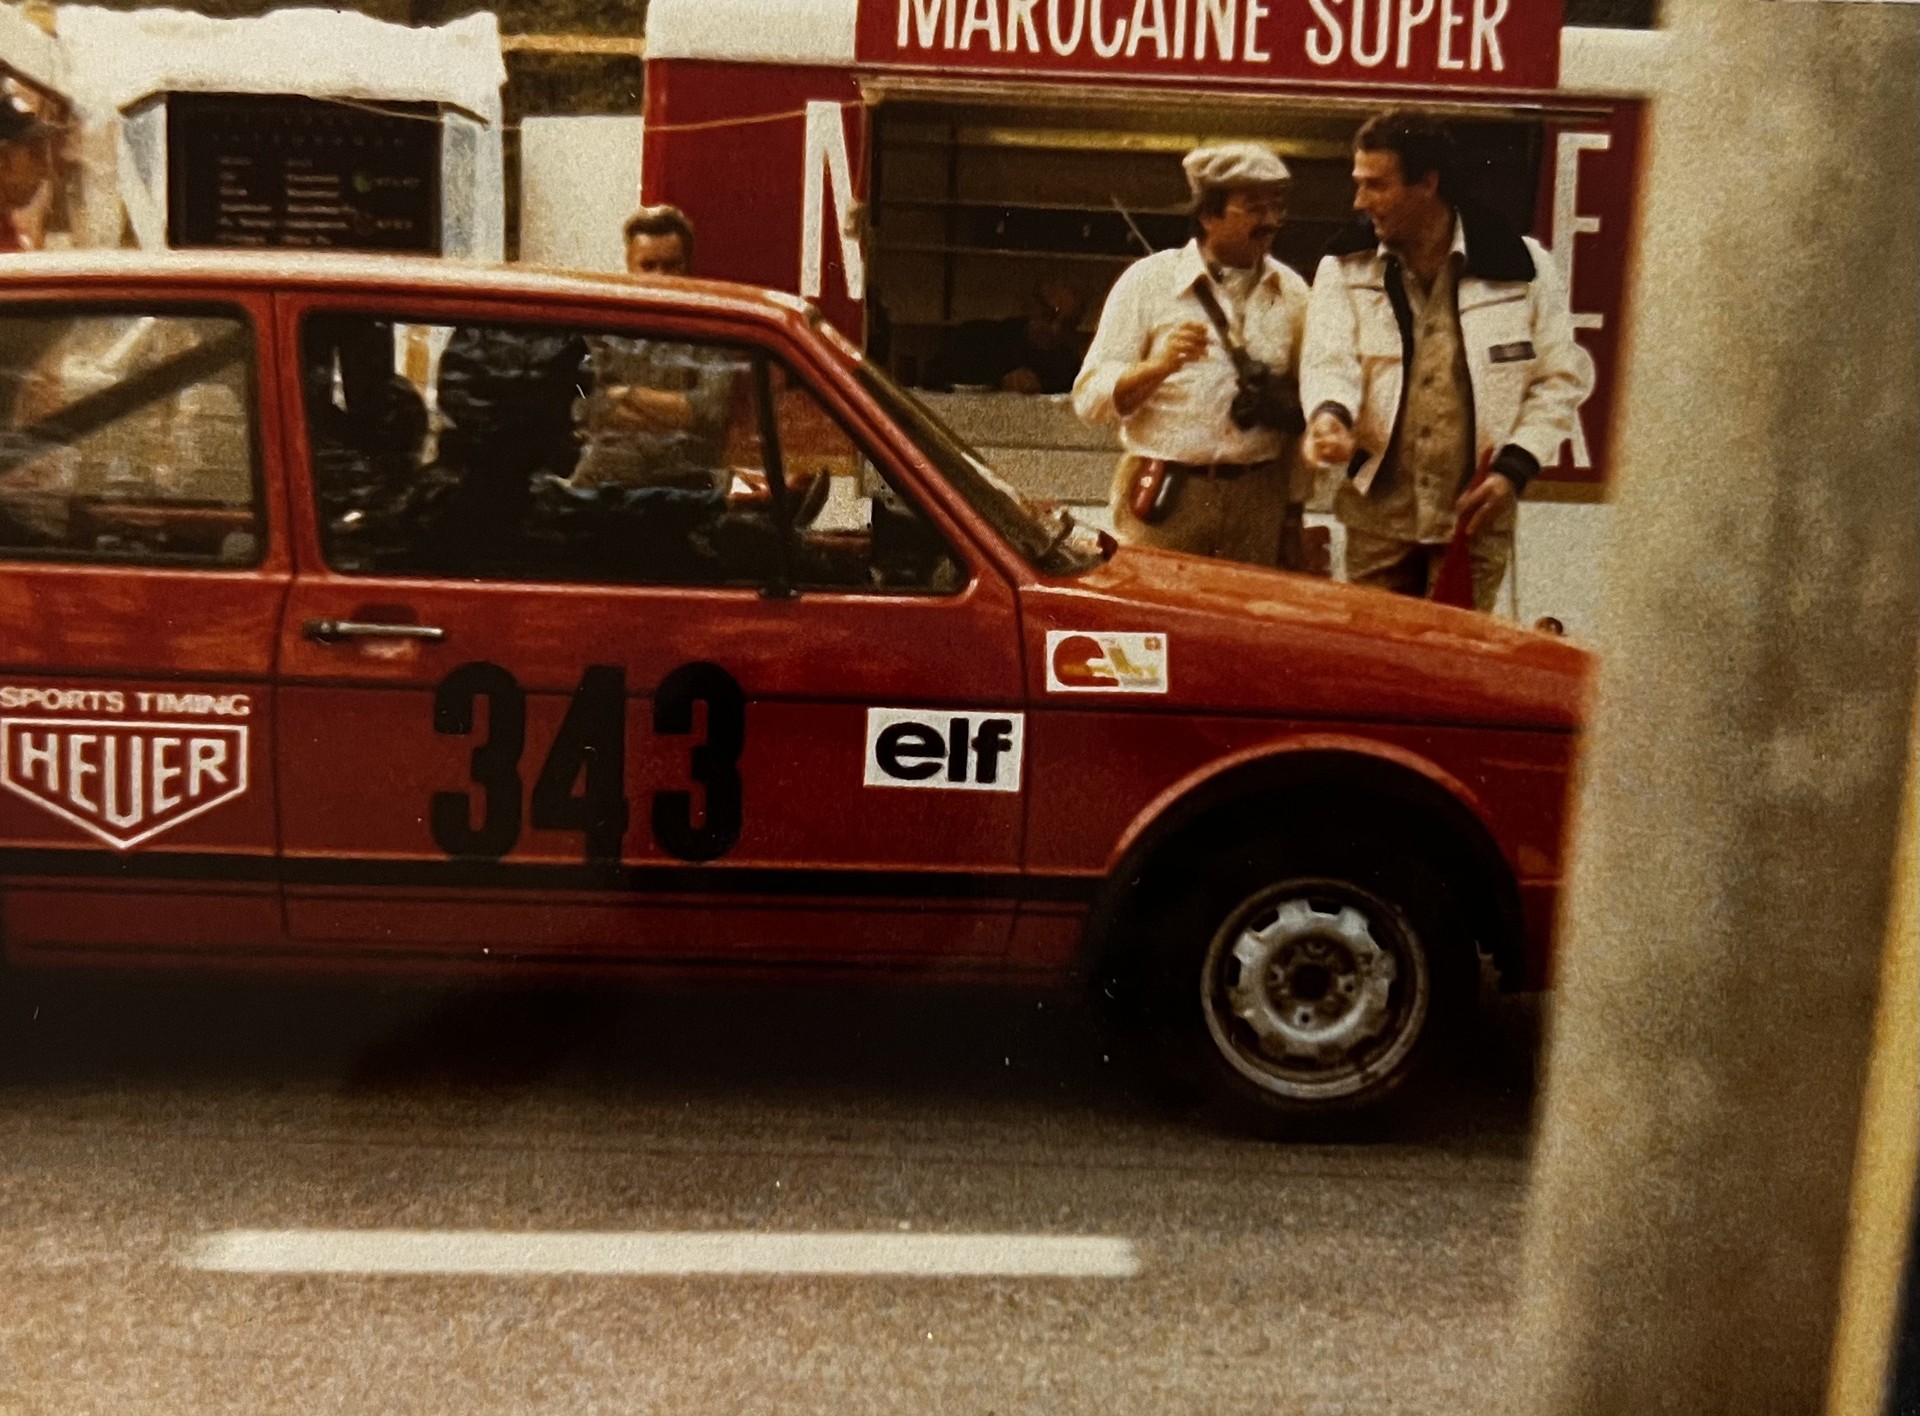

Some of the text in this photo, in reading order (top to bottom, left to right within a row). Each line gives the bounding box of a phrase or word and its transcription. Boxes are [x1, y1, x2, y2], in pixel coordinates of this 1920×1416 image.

[897, 0, 1504, 71] MAROCAINE SUPER
[0, 686, 250, 716] SPORTS TIMING
[20, 731, 229, 829] HEUER
[430, 661, 746, 867] 343
[875, 717, 1013, 784] elf
